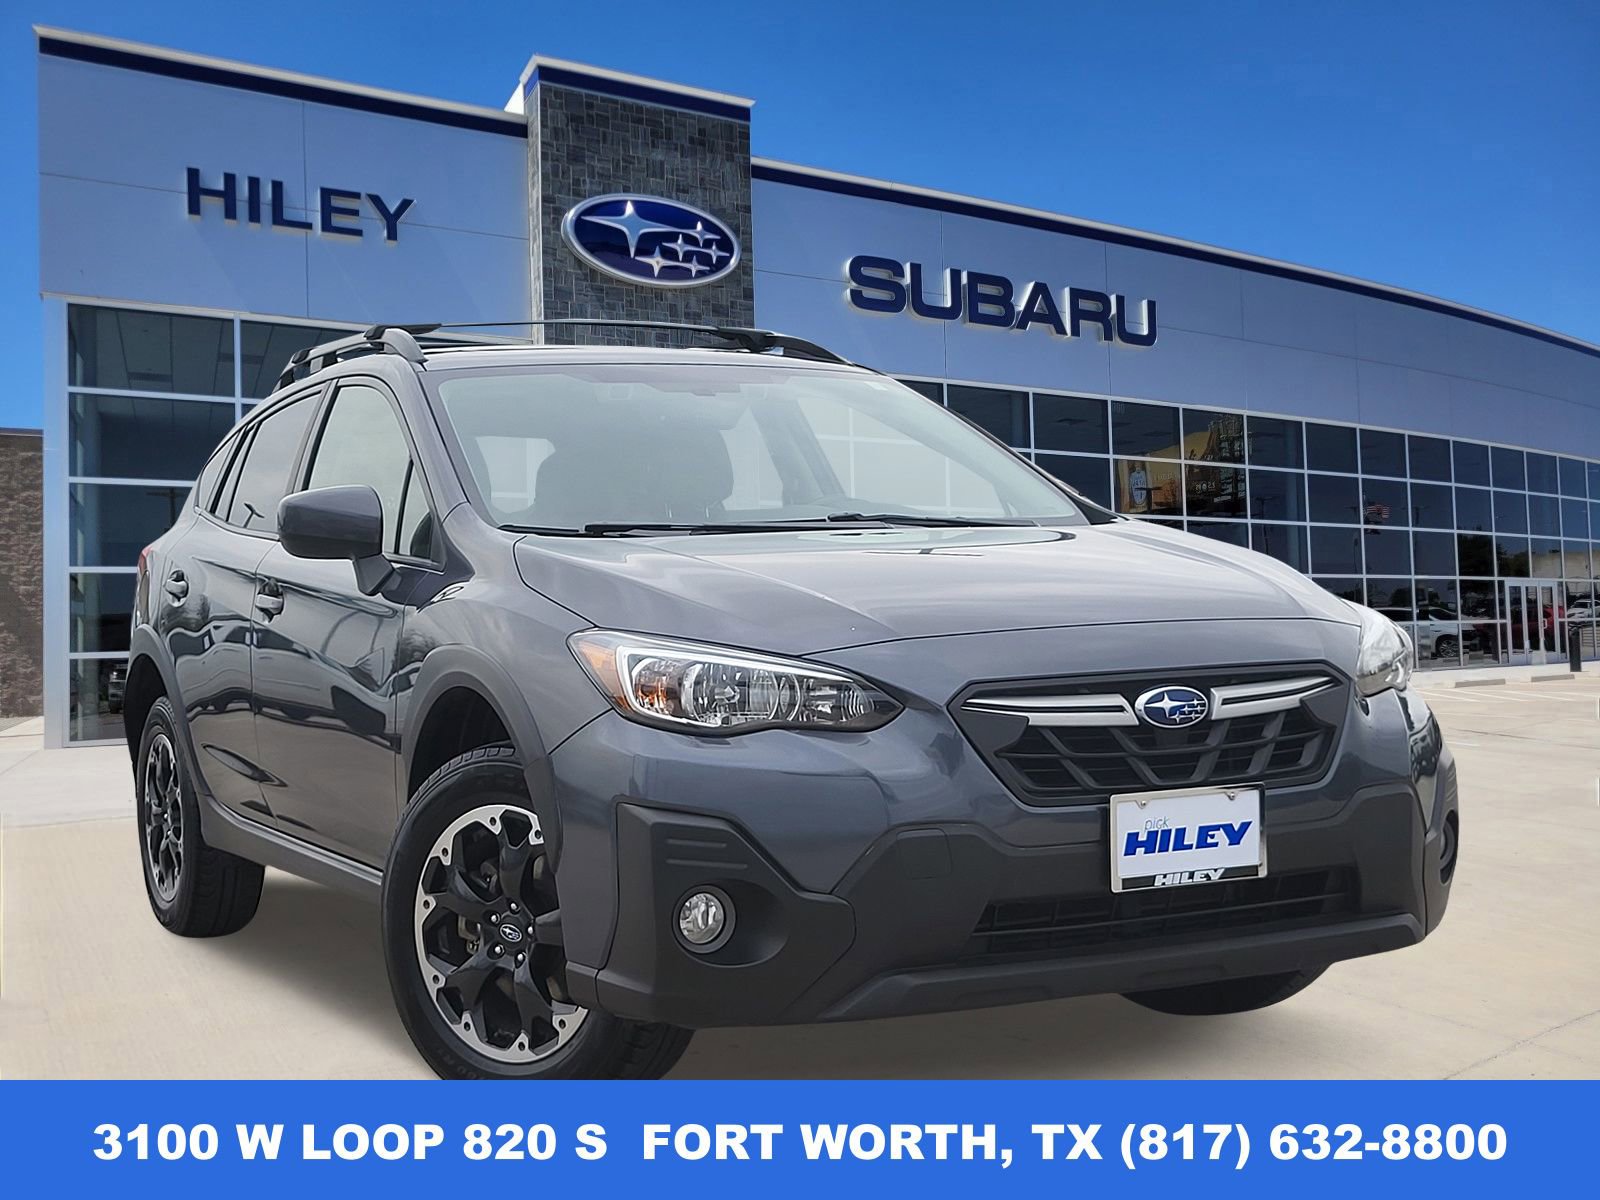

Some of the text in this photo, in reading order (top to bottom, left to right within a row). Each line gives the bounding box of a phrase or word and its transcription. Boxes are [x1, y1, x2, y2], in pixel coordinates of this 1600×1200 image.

[186, 166, 416, 241] HILEY
[847, 255, 1159, 347] SUBARU
[1123, 821, 1253, 857] HILEY
[1144, 816, 1169, 832] pick
[1154, 868, 1225, 887] HILEY
